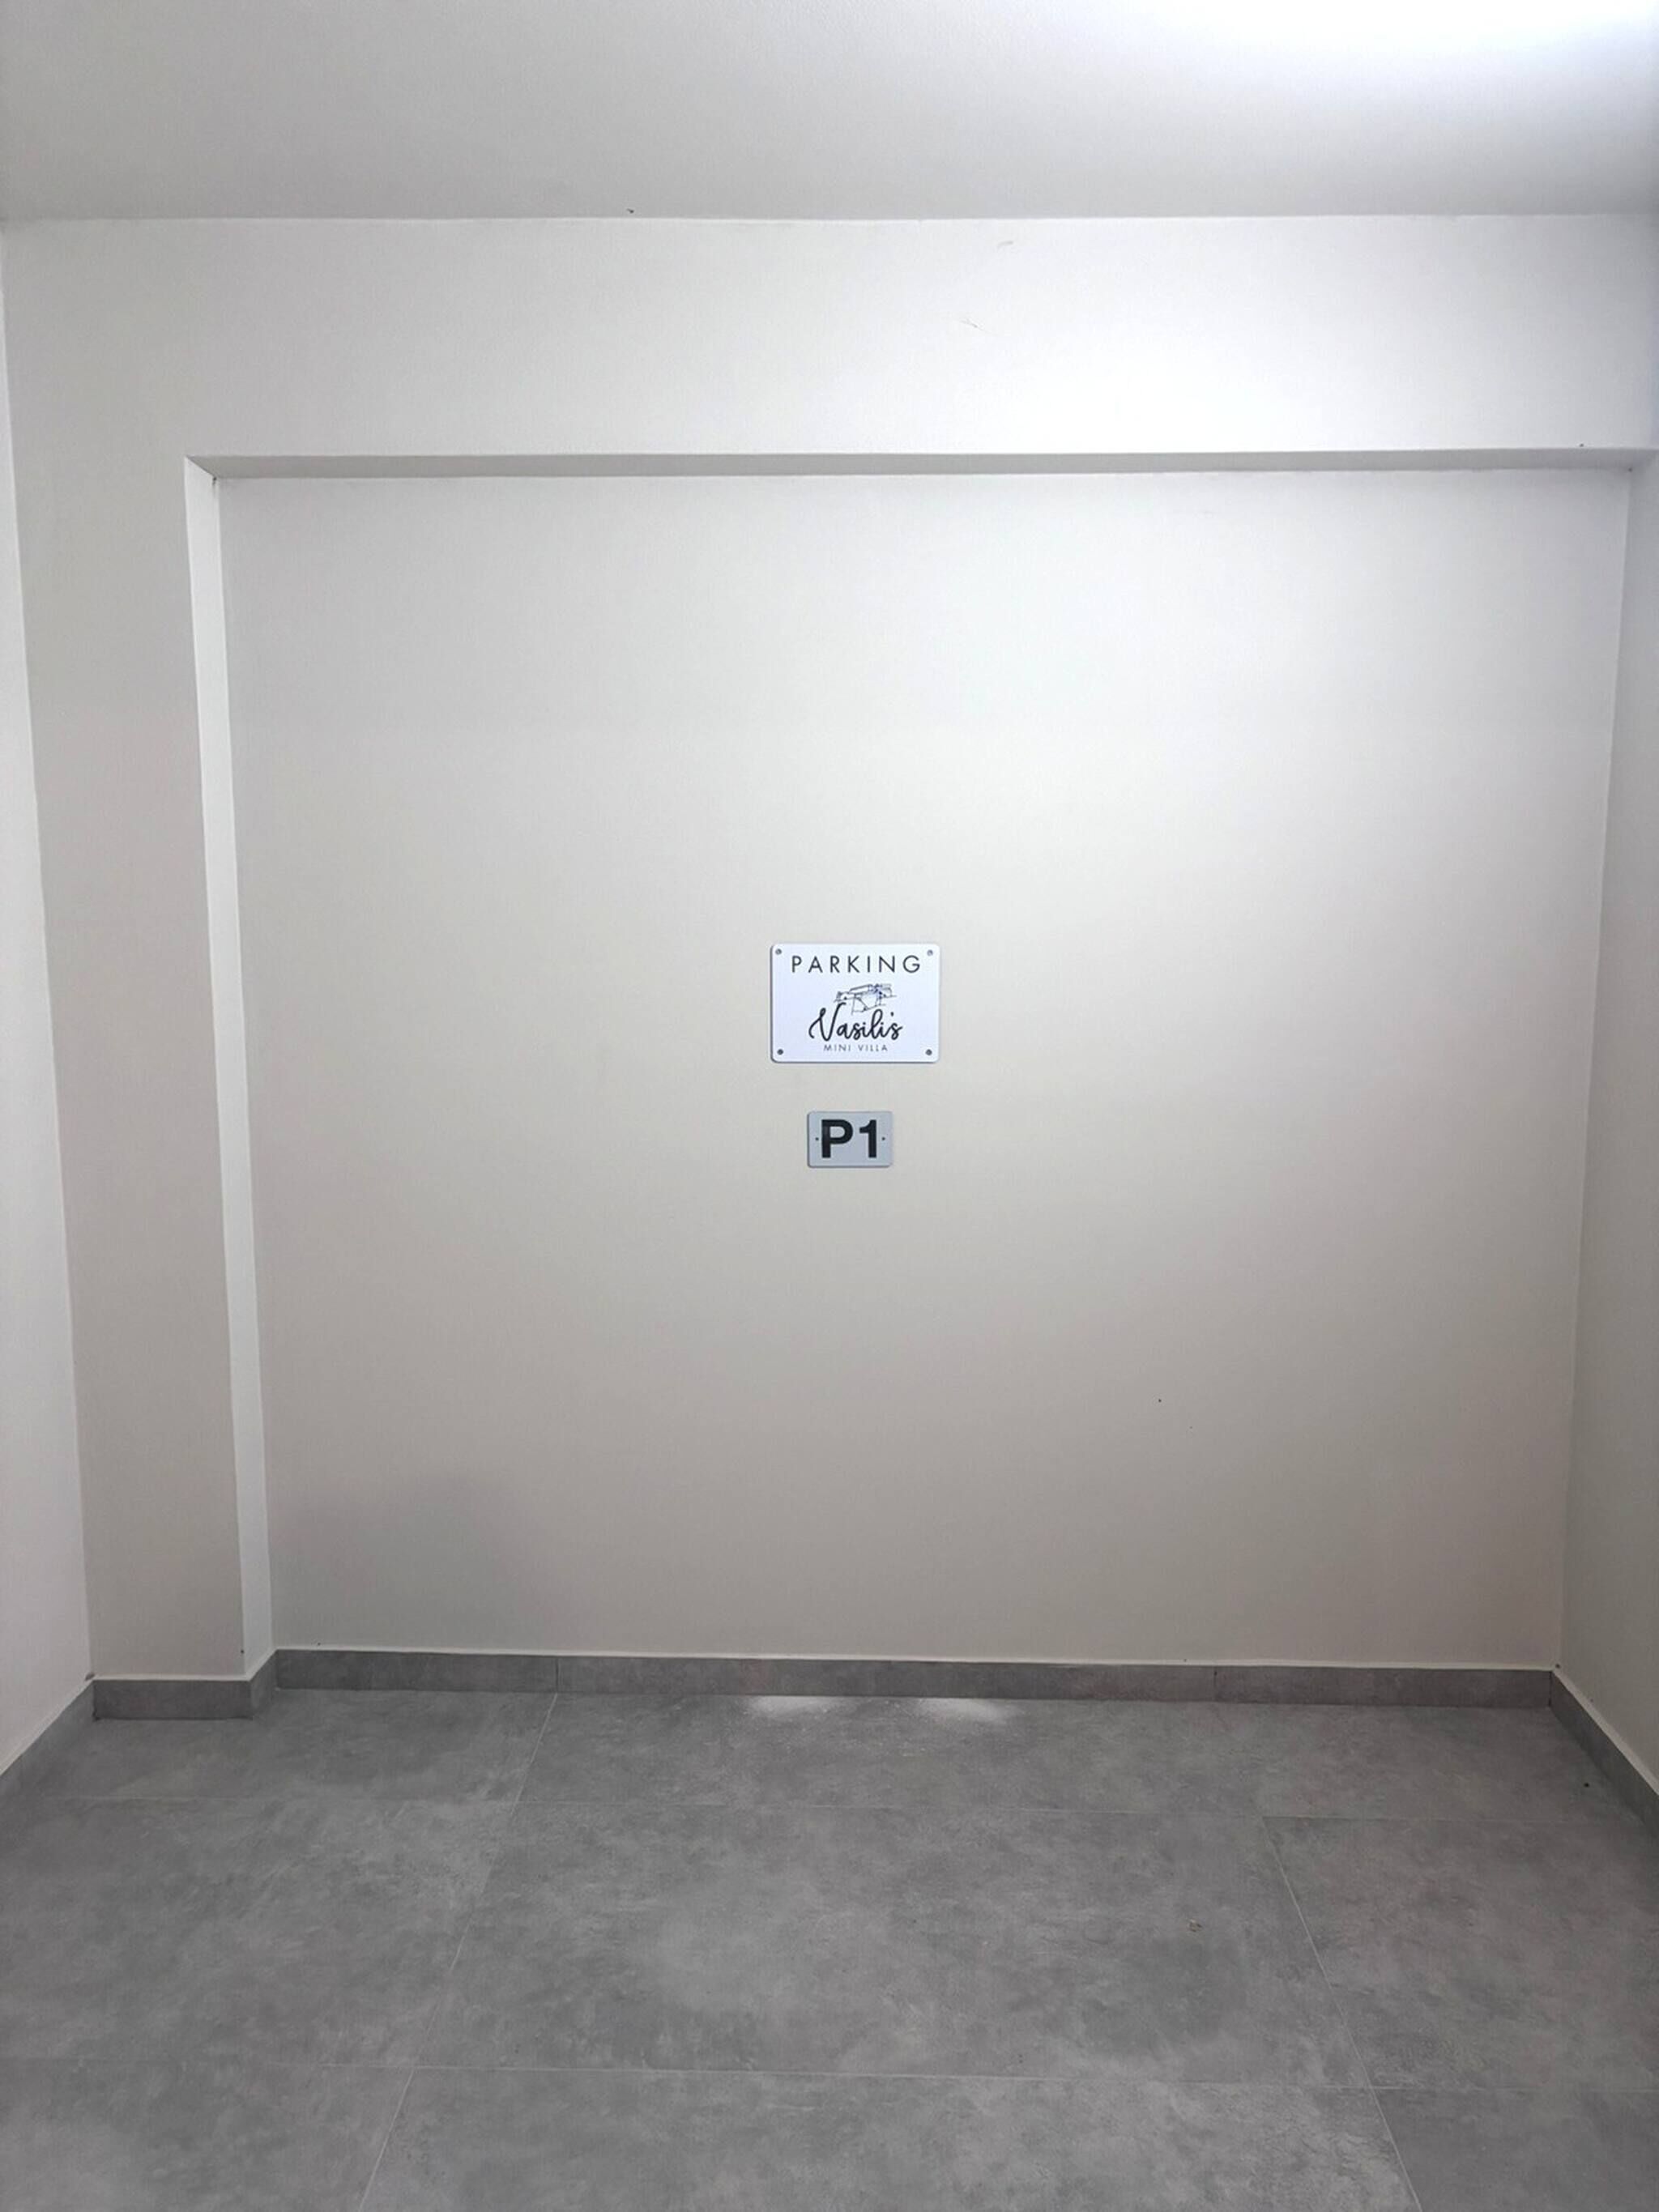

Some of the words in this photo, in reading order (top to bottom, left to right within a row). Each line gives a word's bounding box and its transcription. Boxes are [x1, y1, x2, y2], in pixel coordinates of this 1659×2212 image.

[791, 955, 920, 974] PARKING
[808, 1002, 903, 1042] Vasili's
[823, 1044, 851, 1052] MINI
[858, 1044, 888, 1052] VILLA
[821, 1118, 877, 1159] P1
